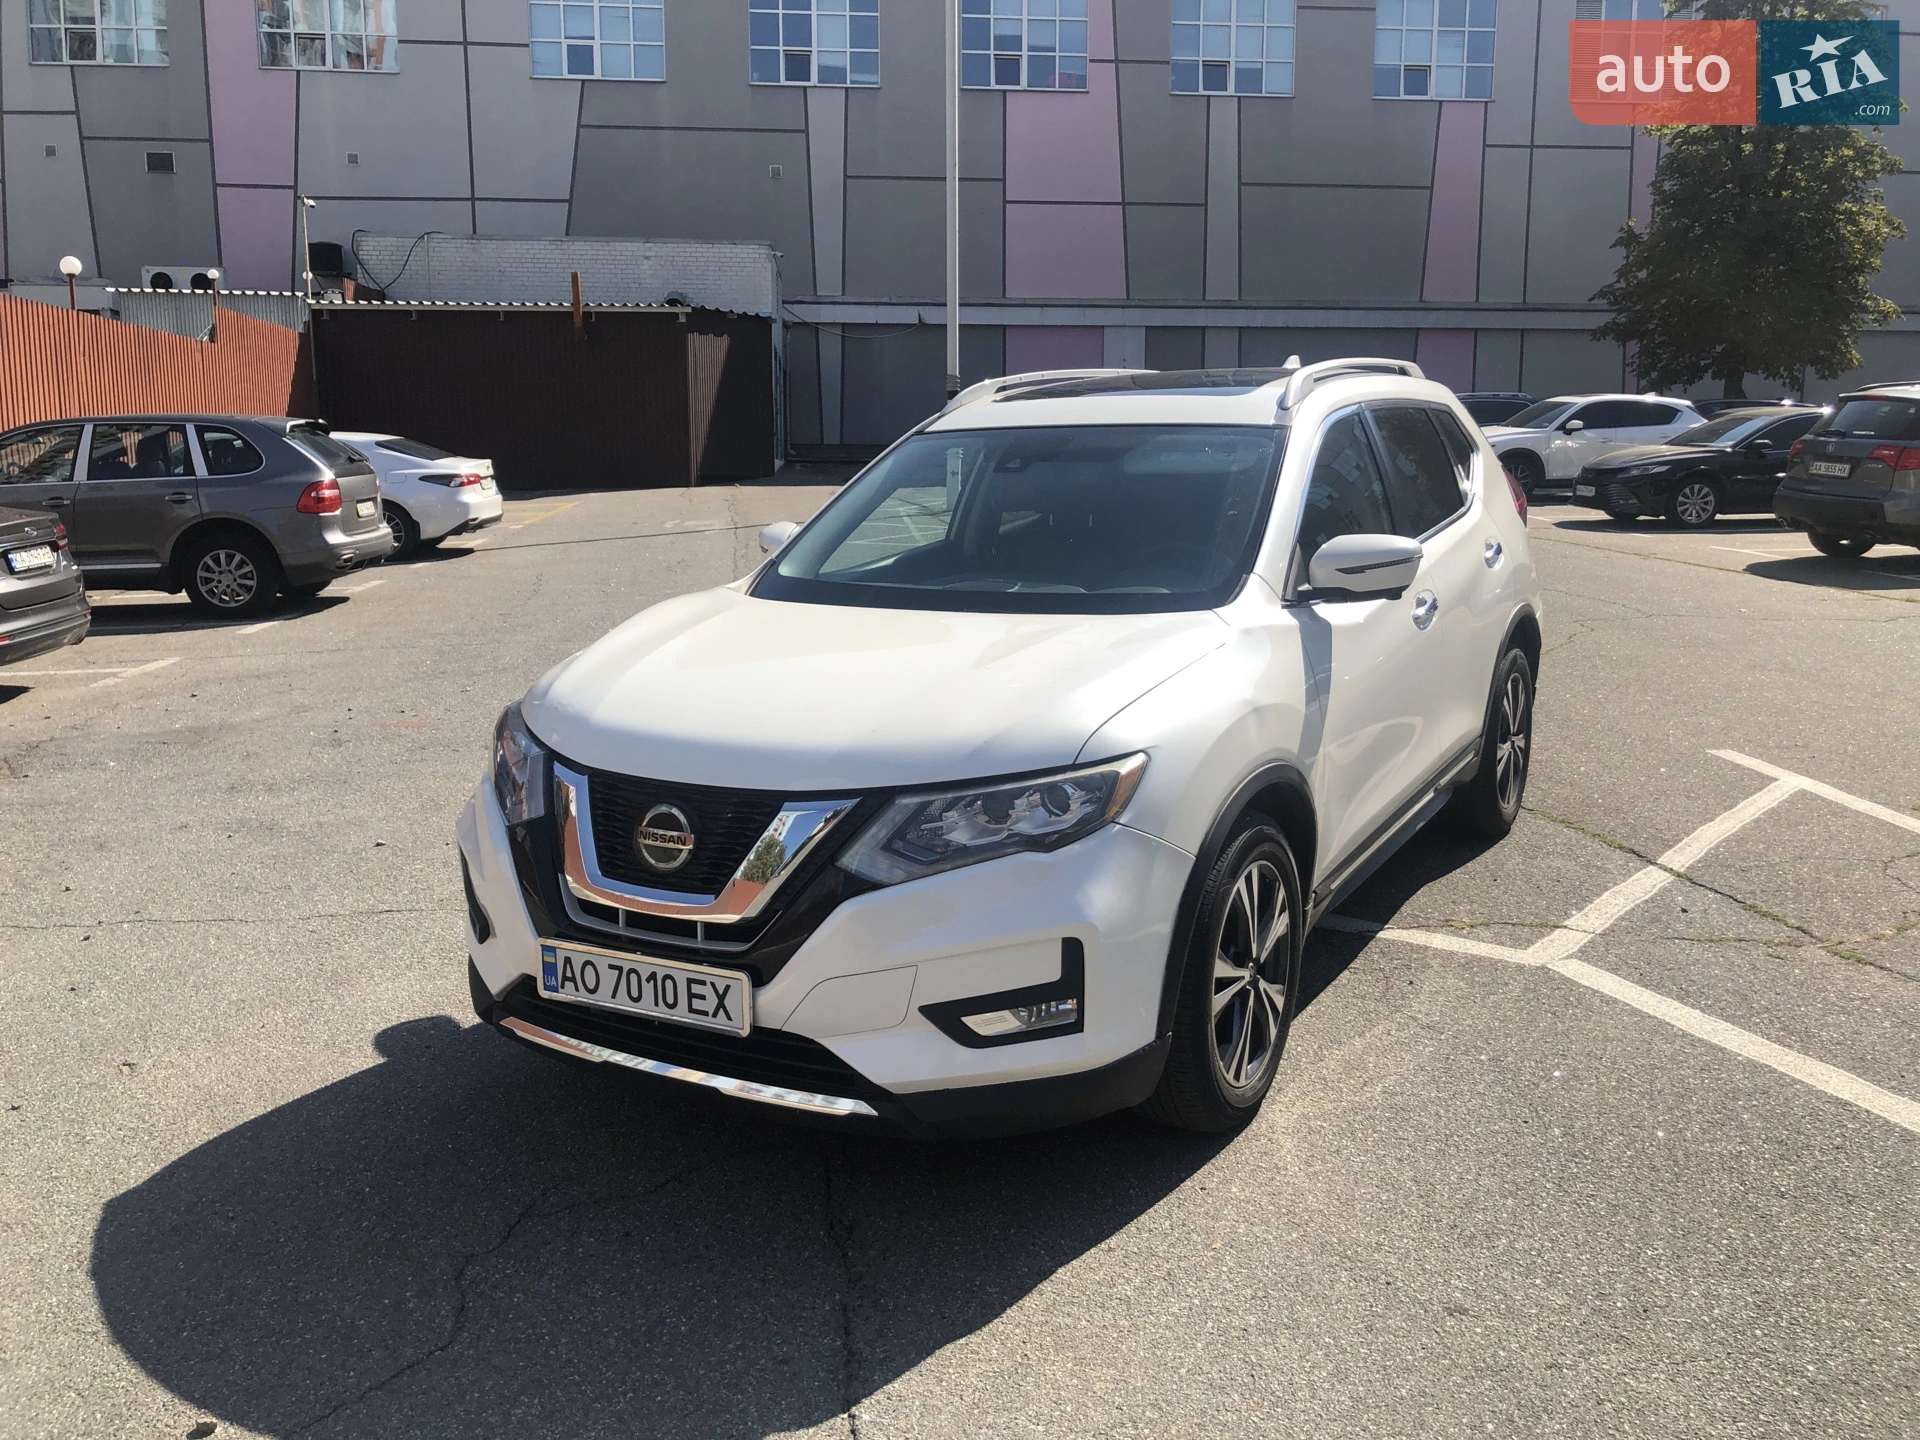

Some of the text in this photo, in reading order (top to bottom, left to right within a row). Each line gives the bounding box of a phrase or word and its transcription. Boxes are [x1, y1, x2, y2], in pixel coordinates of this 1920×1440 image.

[638, 829, 687, 847] NISSAN
[544, 956, 733, 1022] UA AO 7010 EX
